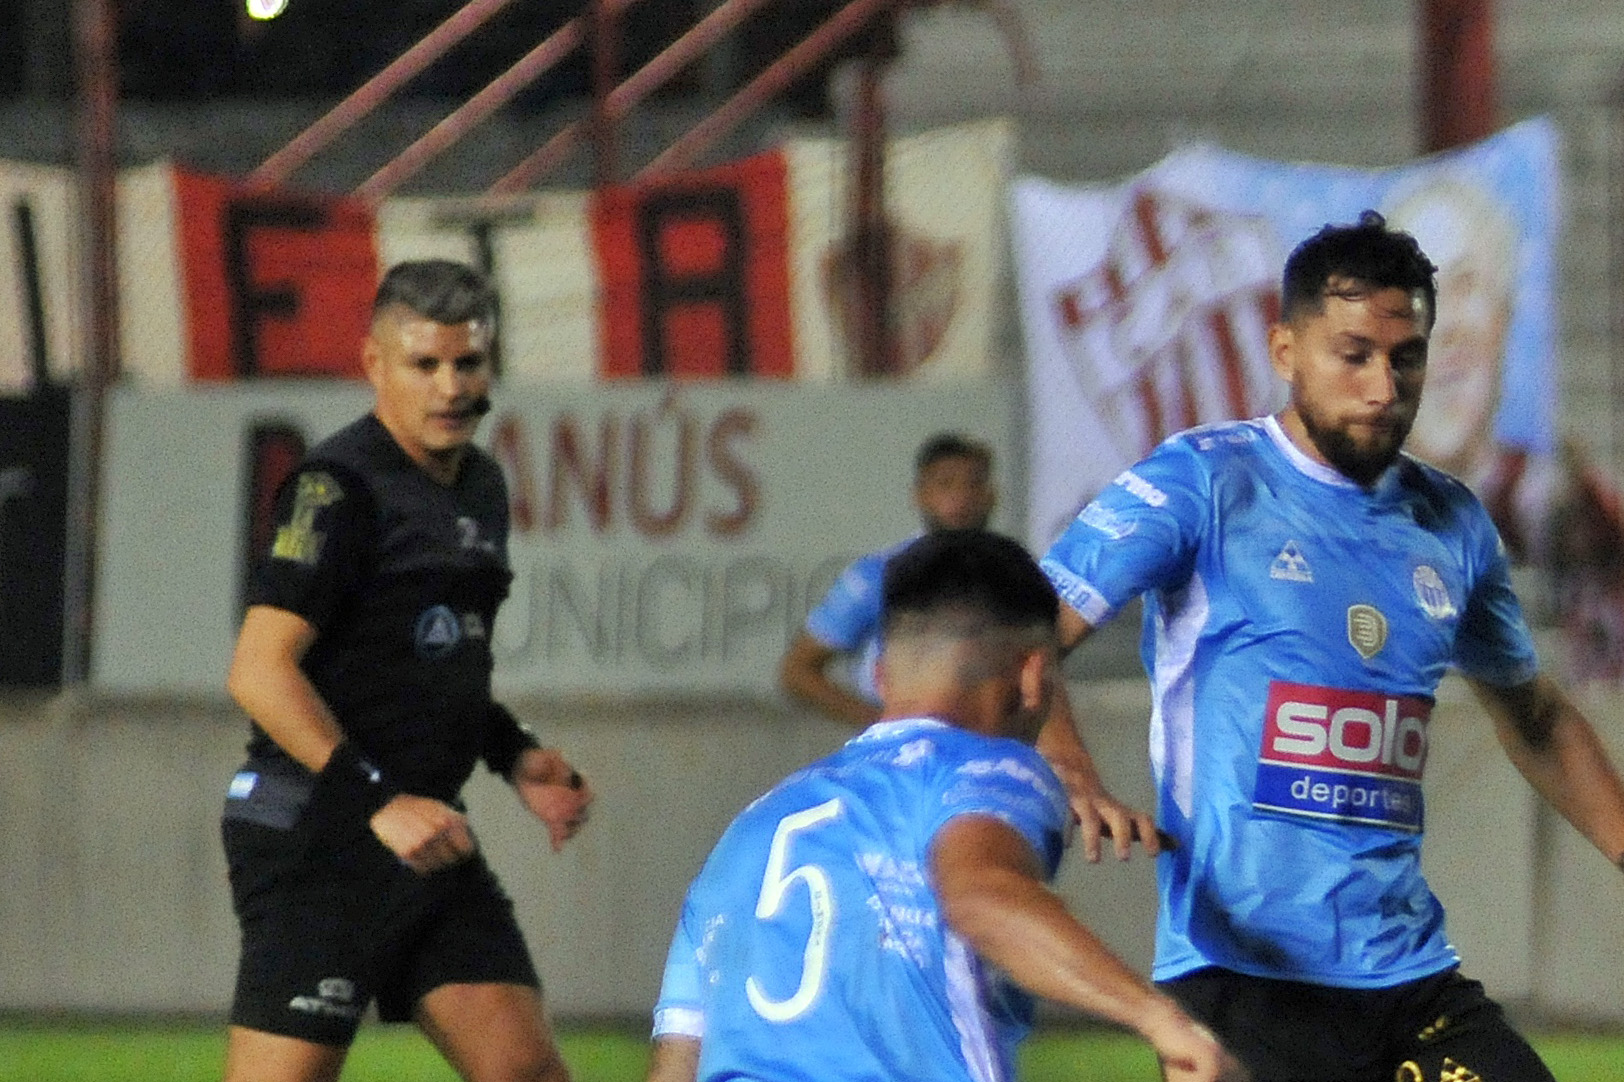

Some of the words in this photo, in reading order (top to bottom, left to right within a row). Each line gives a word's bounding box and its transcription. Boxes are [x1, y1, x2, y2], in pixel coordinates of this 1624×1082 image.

[490, 385, 764, 540] ANÚS
[1273, 700, 1427, 771] solo
[745, 798, 840, 1022] 5
